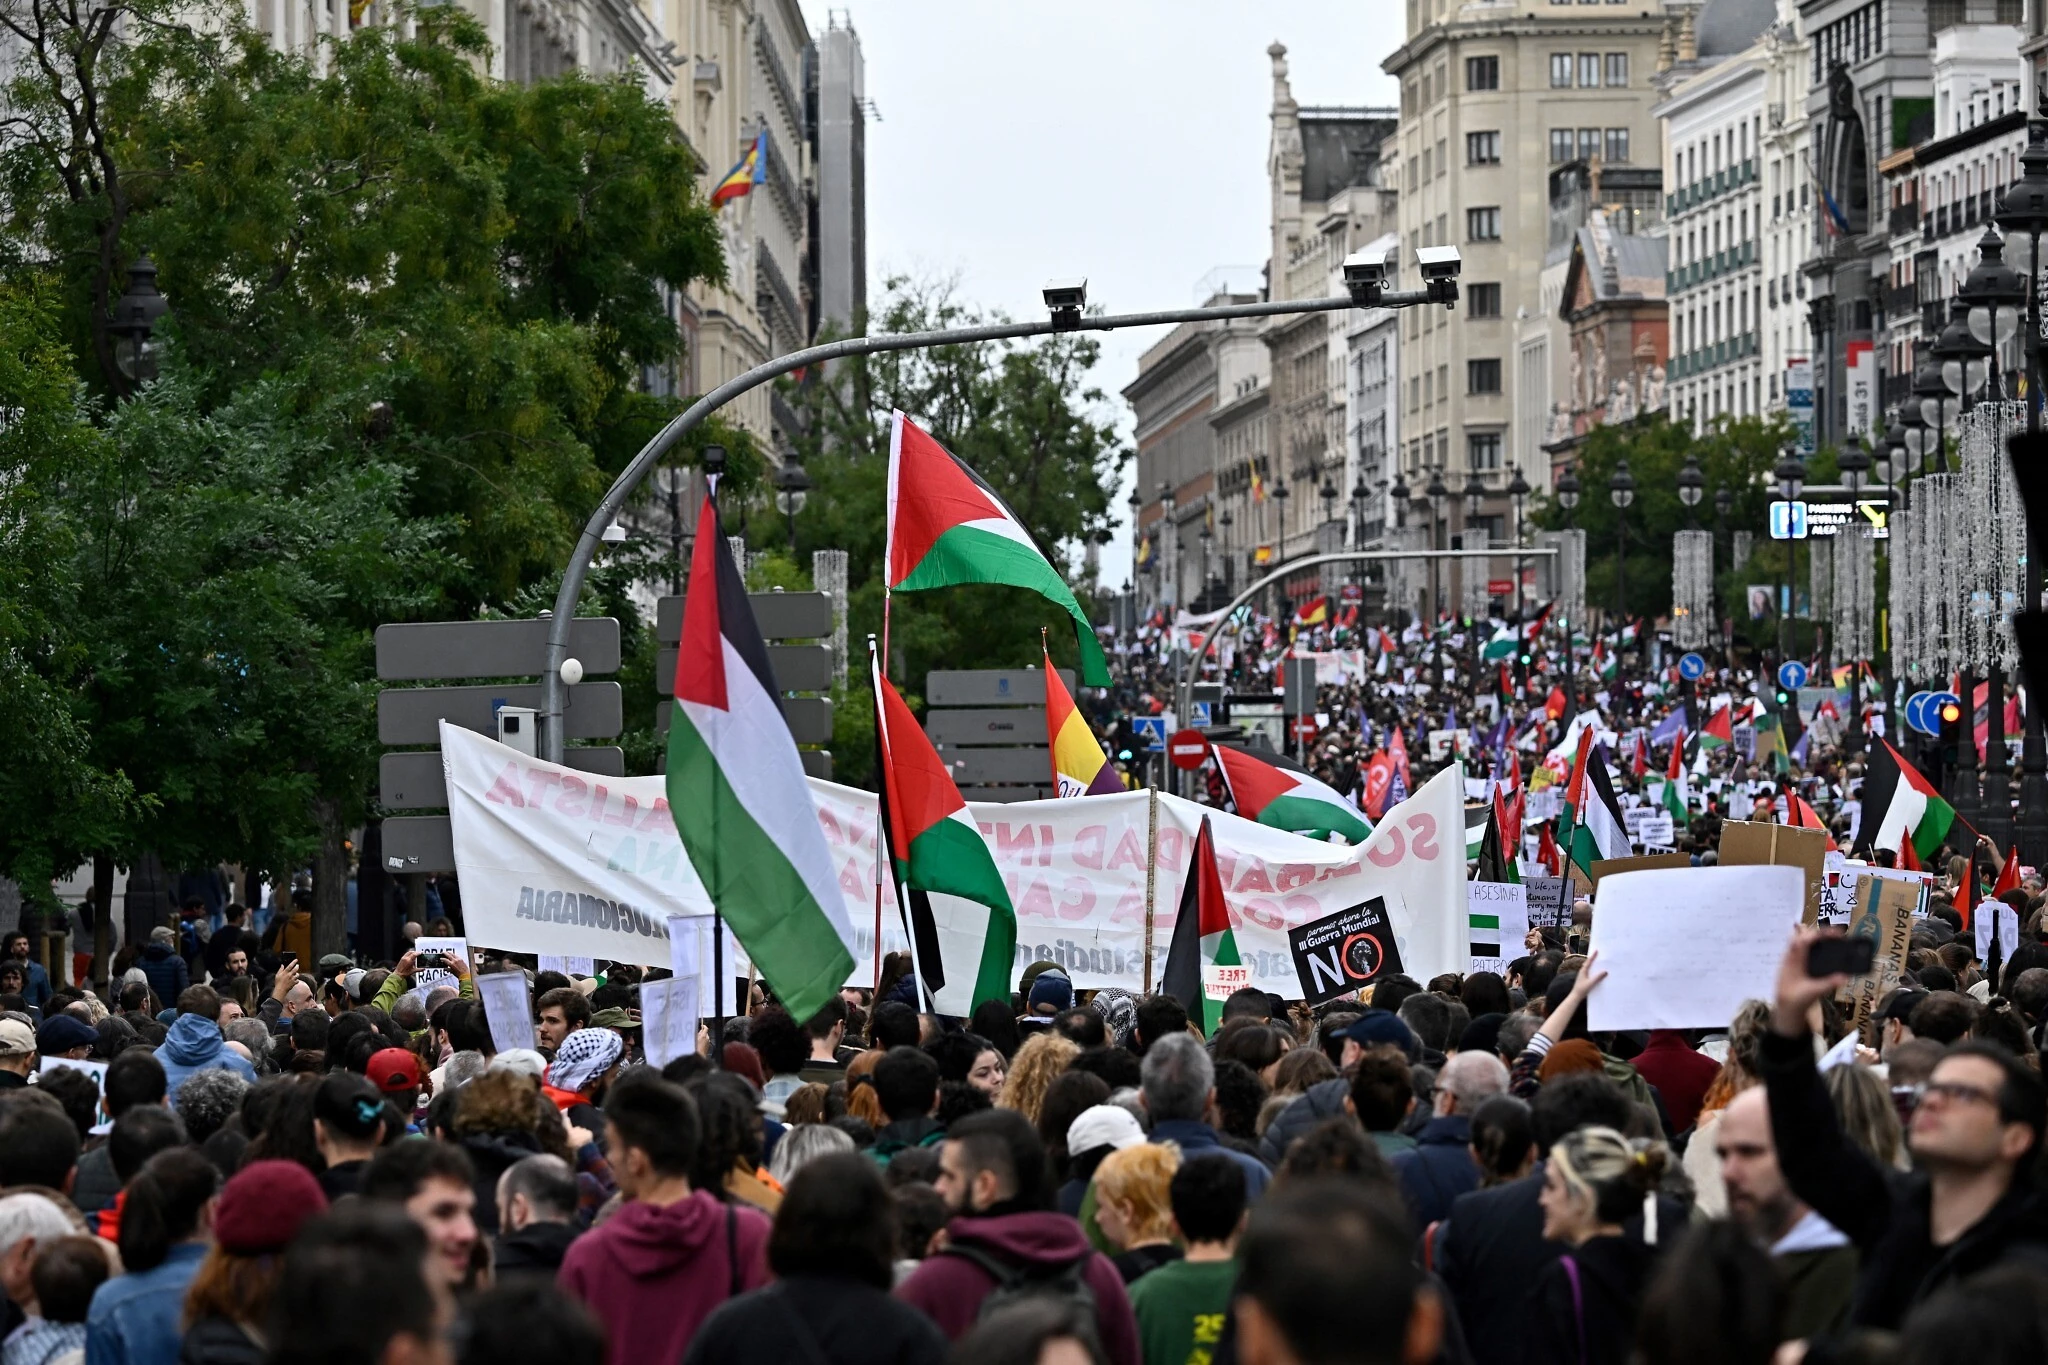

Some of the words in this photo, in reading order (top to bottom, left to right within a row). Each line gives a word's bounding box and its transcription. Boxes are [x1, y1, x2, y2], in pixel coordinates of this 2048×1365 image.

[1854, 380, 1868, 399] 31
[1305, 920, 1338, 942] paremos
[1338, 910, 1361, 927] ahora
[1361, 906, 1372, 918] la
[1307, 929, 1341, 948] Guerra
[1341, 914, 1381, 936] Mundial
[1884, 907, 1909, 984] BANANAS
